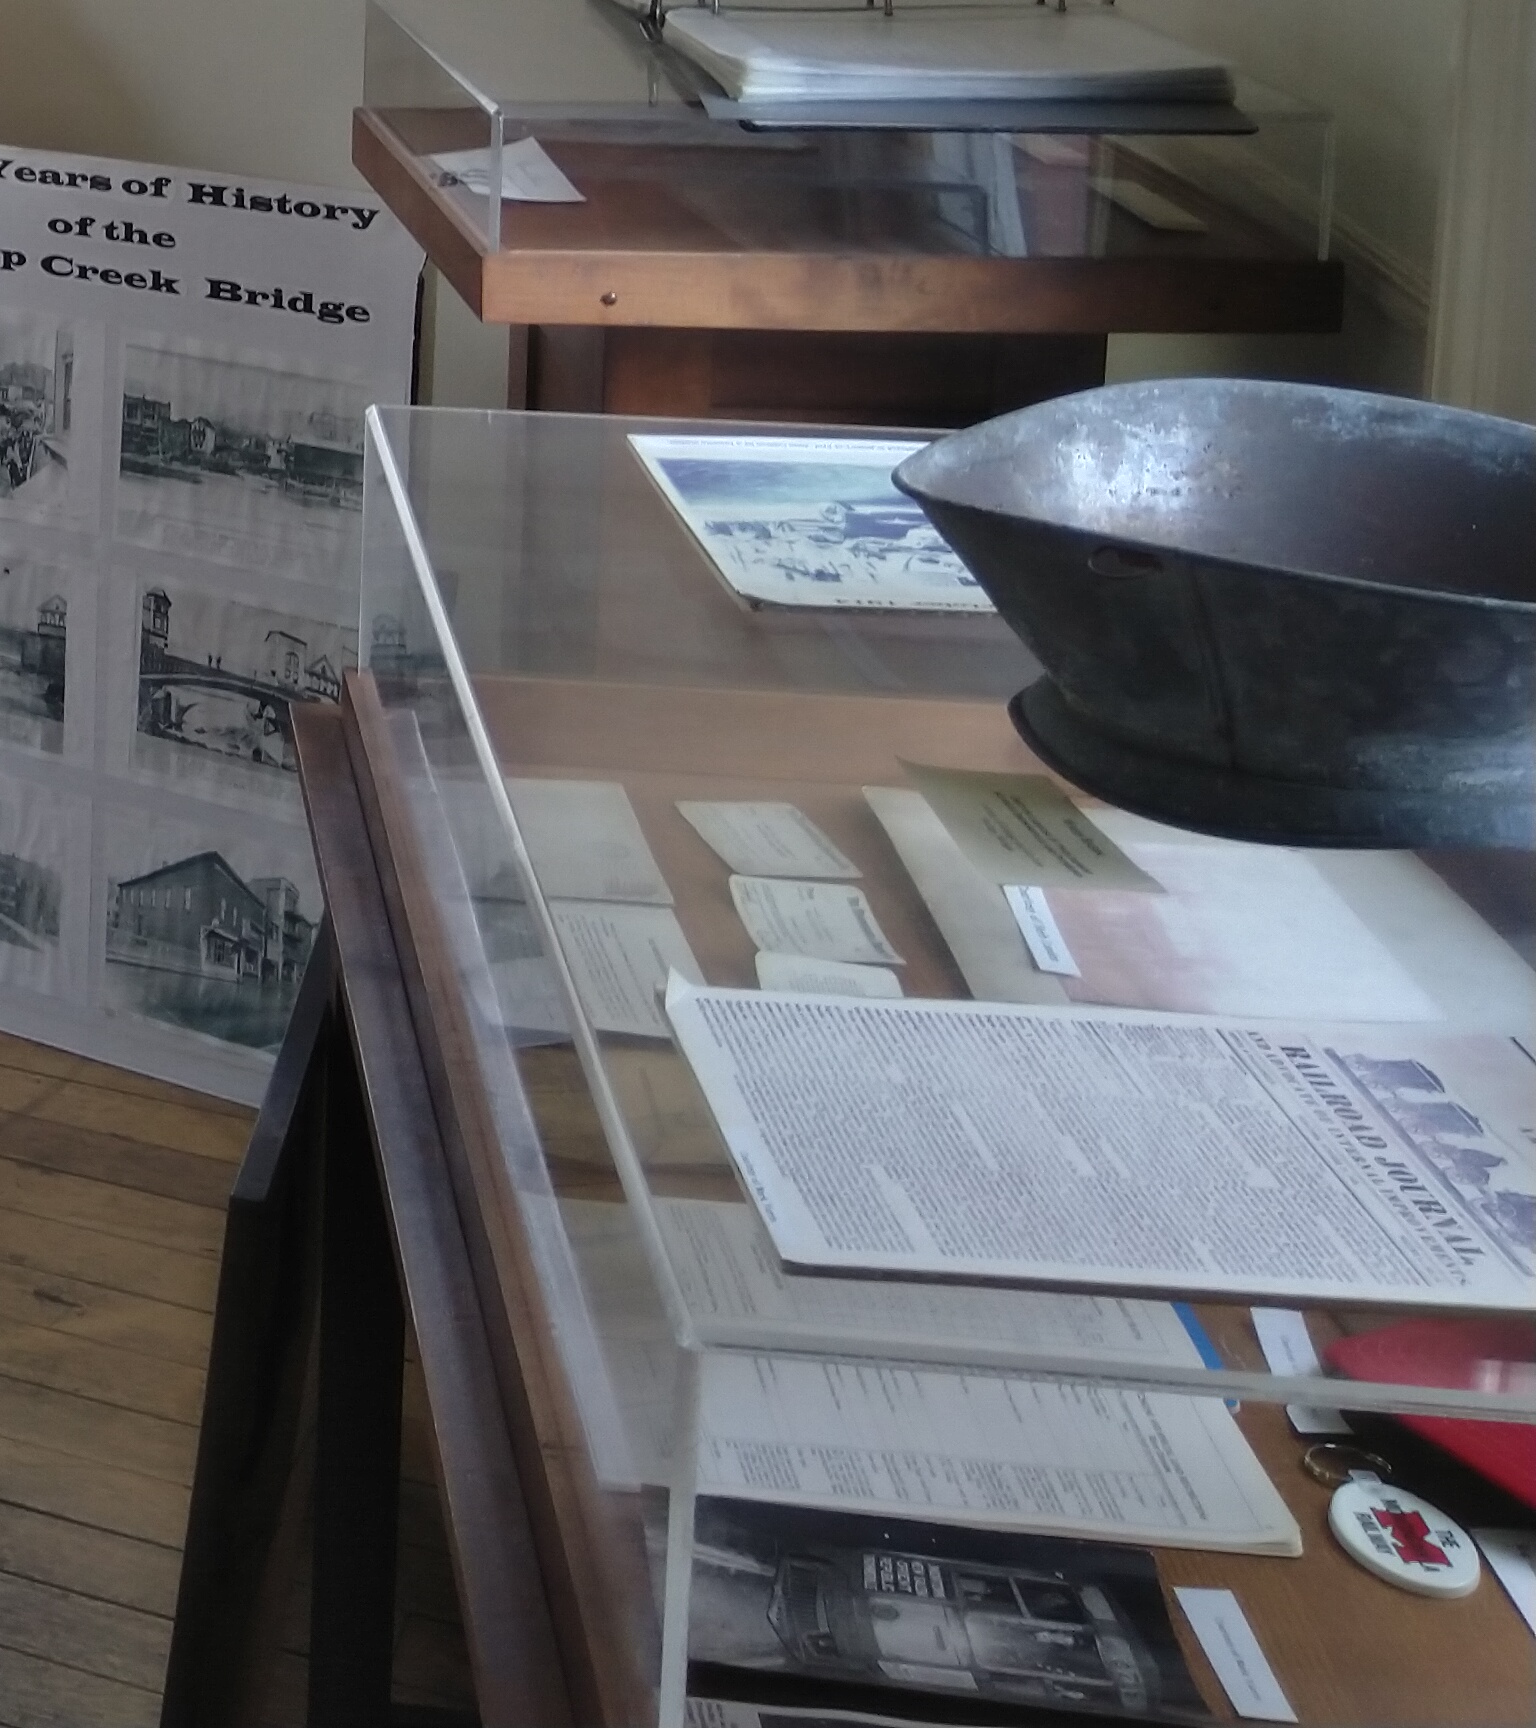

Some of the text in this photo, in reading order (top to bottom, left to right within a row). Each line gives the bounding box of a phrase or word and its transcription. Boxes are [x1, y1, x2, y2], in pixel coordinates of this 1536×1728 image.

[47, 216, 177, 249] of the
[121, 176, 172, 198] of
[186, 182, 380, 230] History
[39, 255, 183, 296] Creek
[204, 276, 372, 326] Bridge
[1279, 1045, 1388, 1150] RAILROAD
